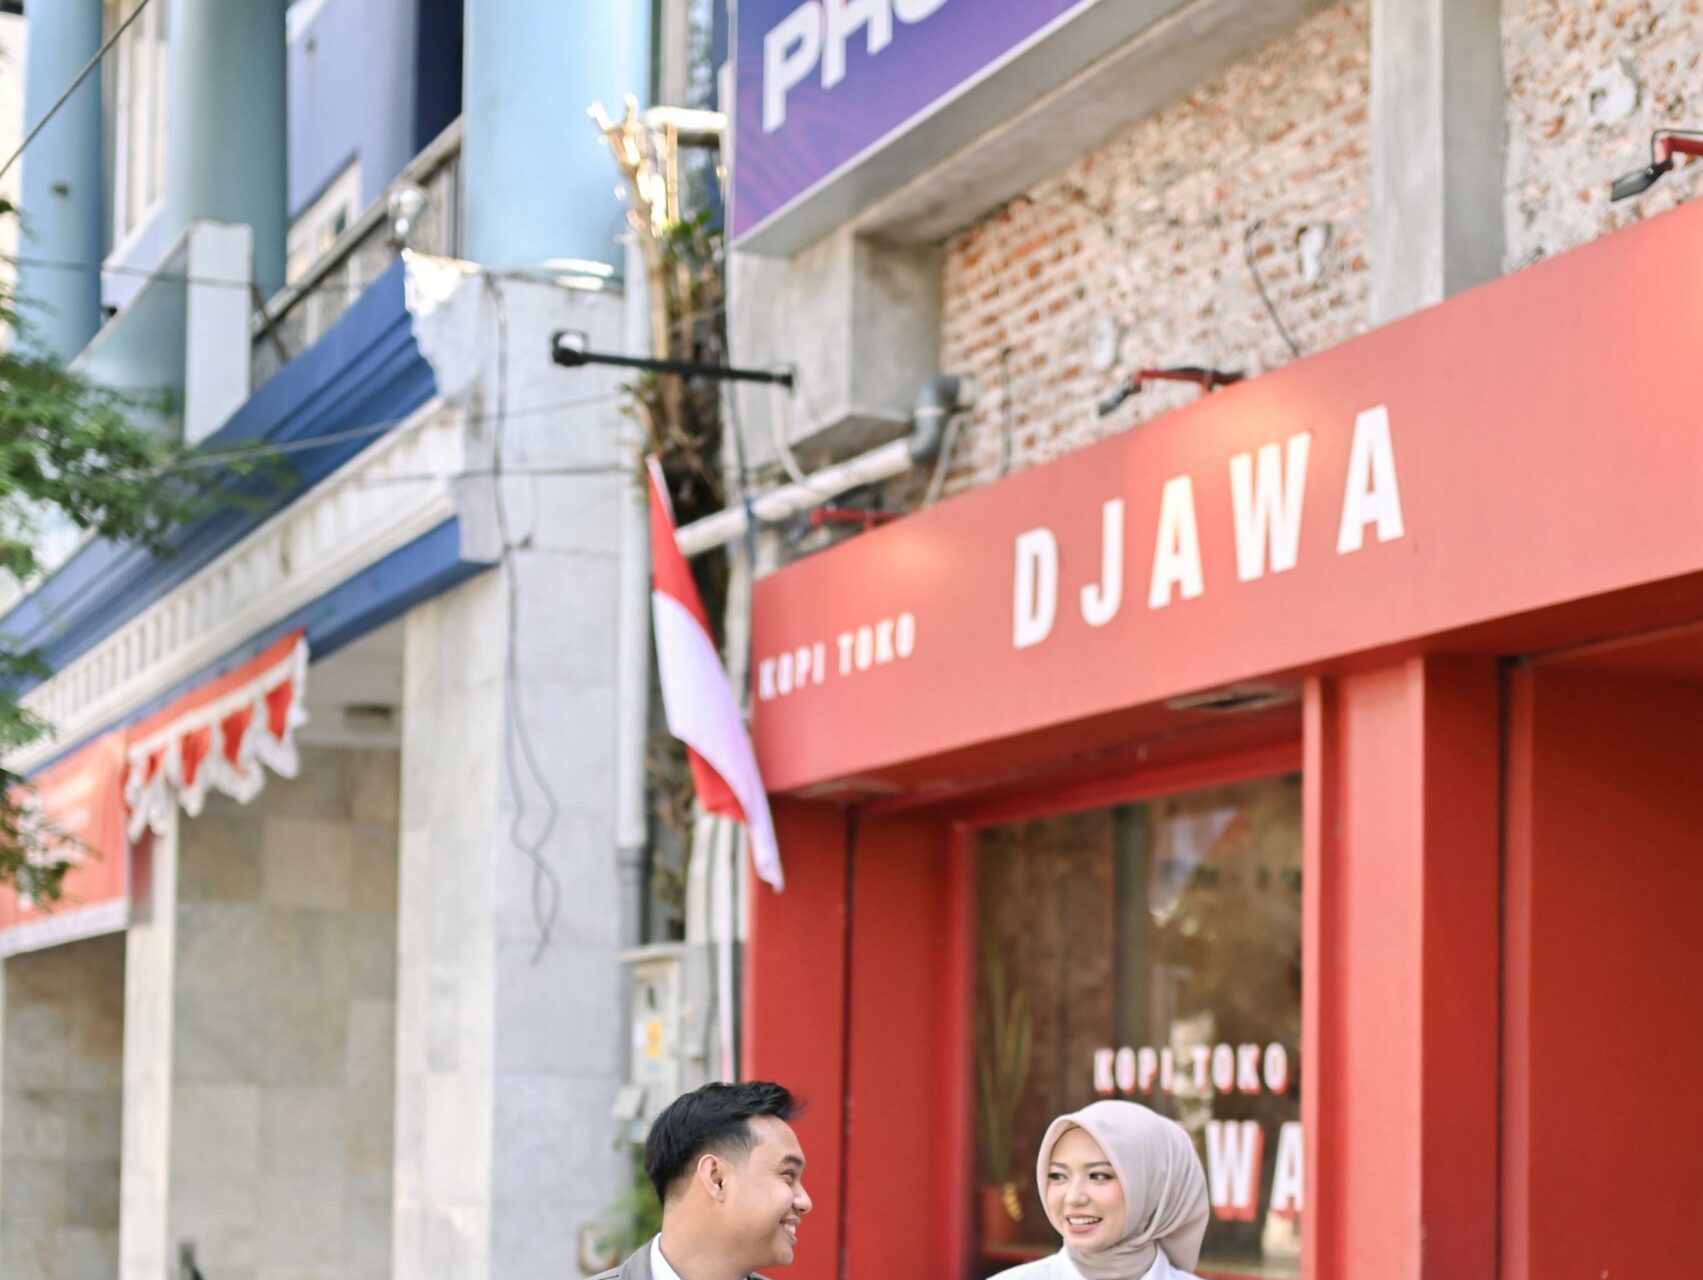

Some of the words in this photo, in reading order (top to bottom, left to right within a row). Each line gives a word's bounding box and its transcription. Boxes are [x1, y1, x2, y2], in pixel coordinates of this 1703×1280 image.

[761, 0, 950, 134] PH
[758, 641, 826, 701] KOPI
[836, 610, 915, 677] TOKO
[1012, 403, 1405, 650] DJAWA
[1093, 1046, 1176, 1095] KOPI
[1191, 1042, 1289, 1095] TOKO
